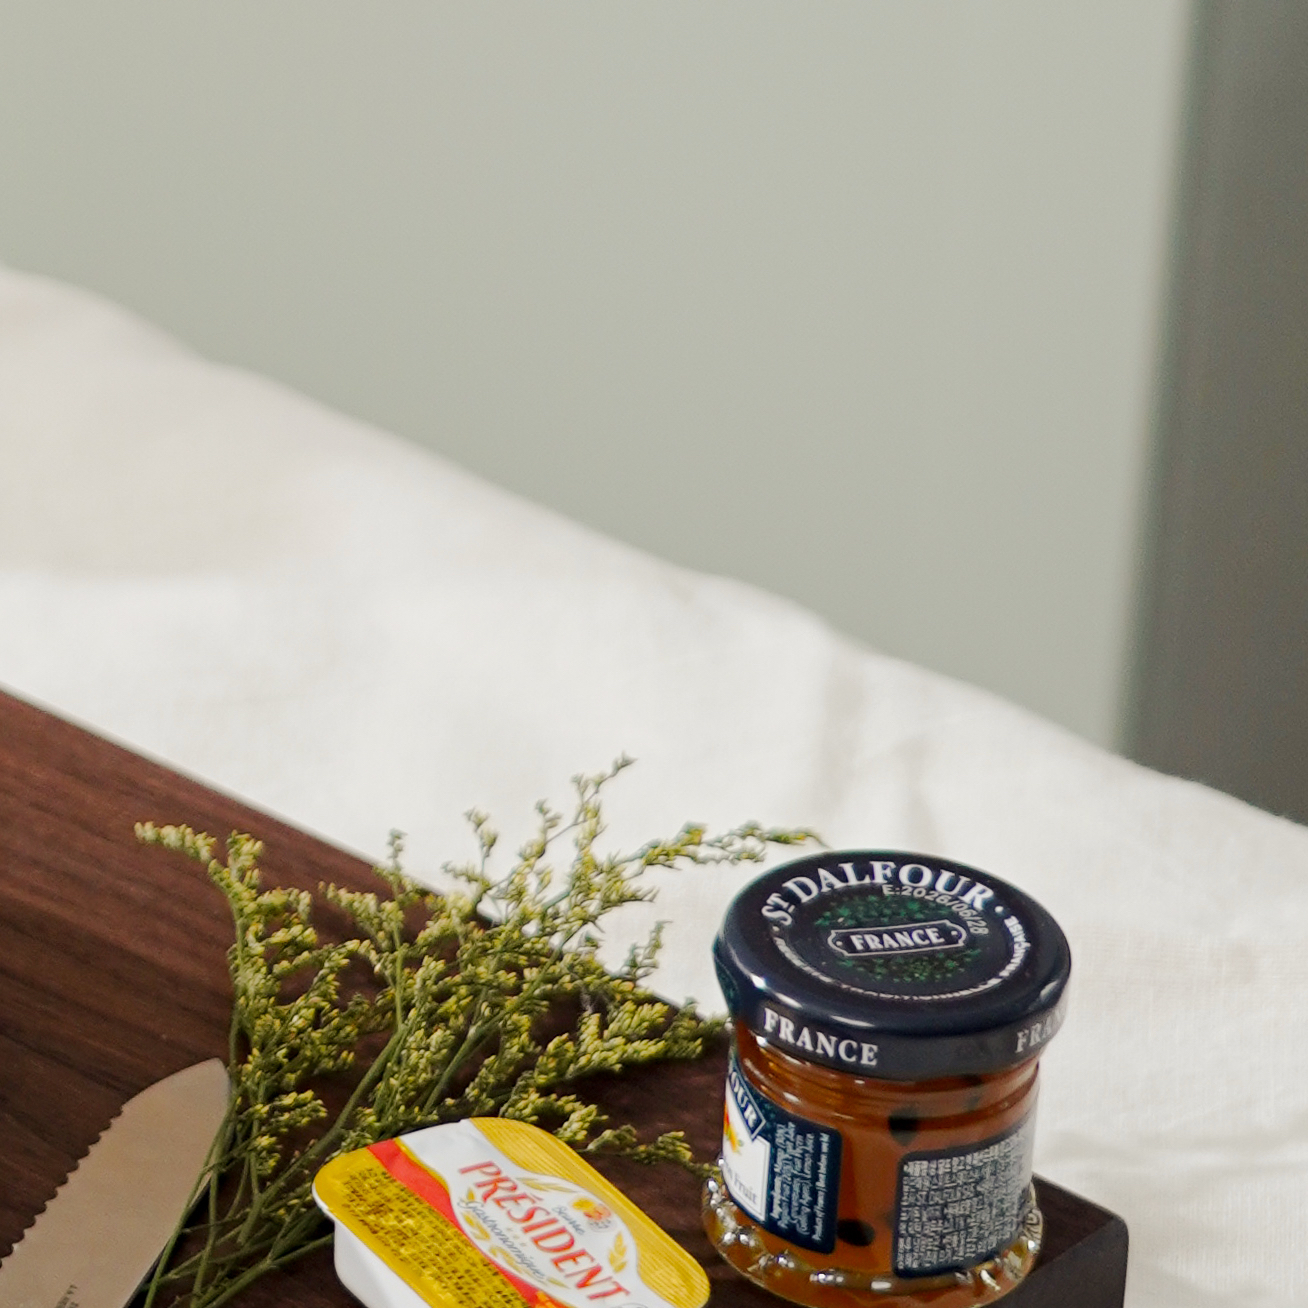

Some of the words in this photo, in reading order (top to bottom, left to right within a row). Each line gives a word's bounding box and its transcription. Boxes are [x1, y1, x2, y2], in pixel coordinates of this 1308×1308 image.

[781, 860, 997, 911] DALFOUR
[849, 927, 946, 952] FRANCE
[762, 1006, 880, 1067] FRANCE
[458, 1160, 631, 1303] PRÉSIDENT
